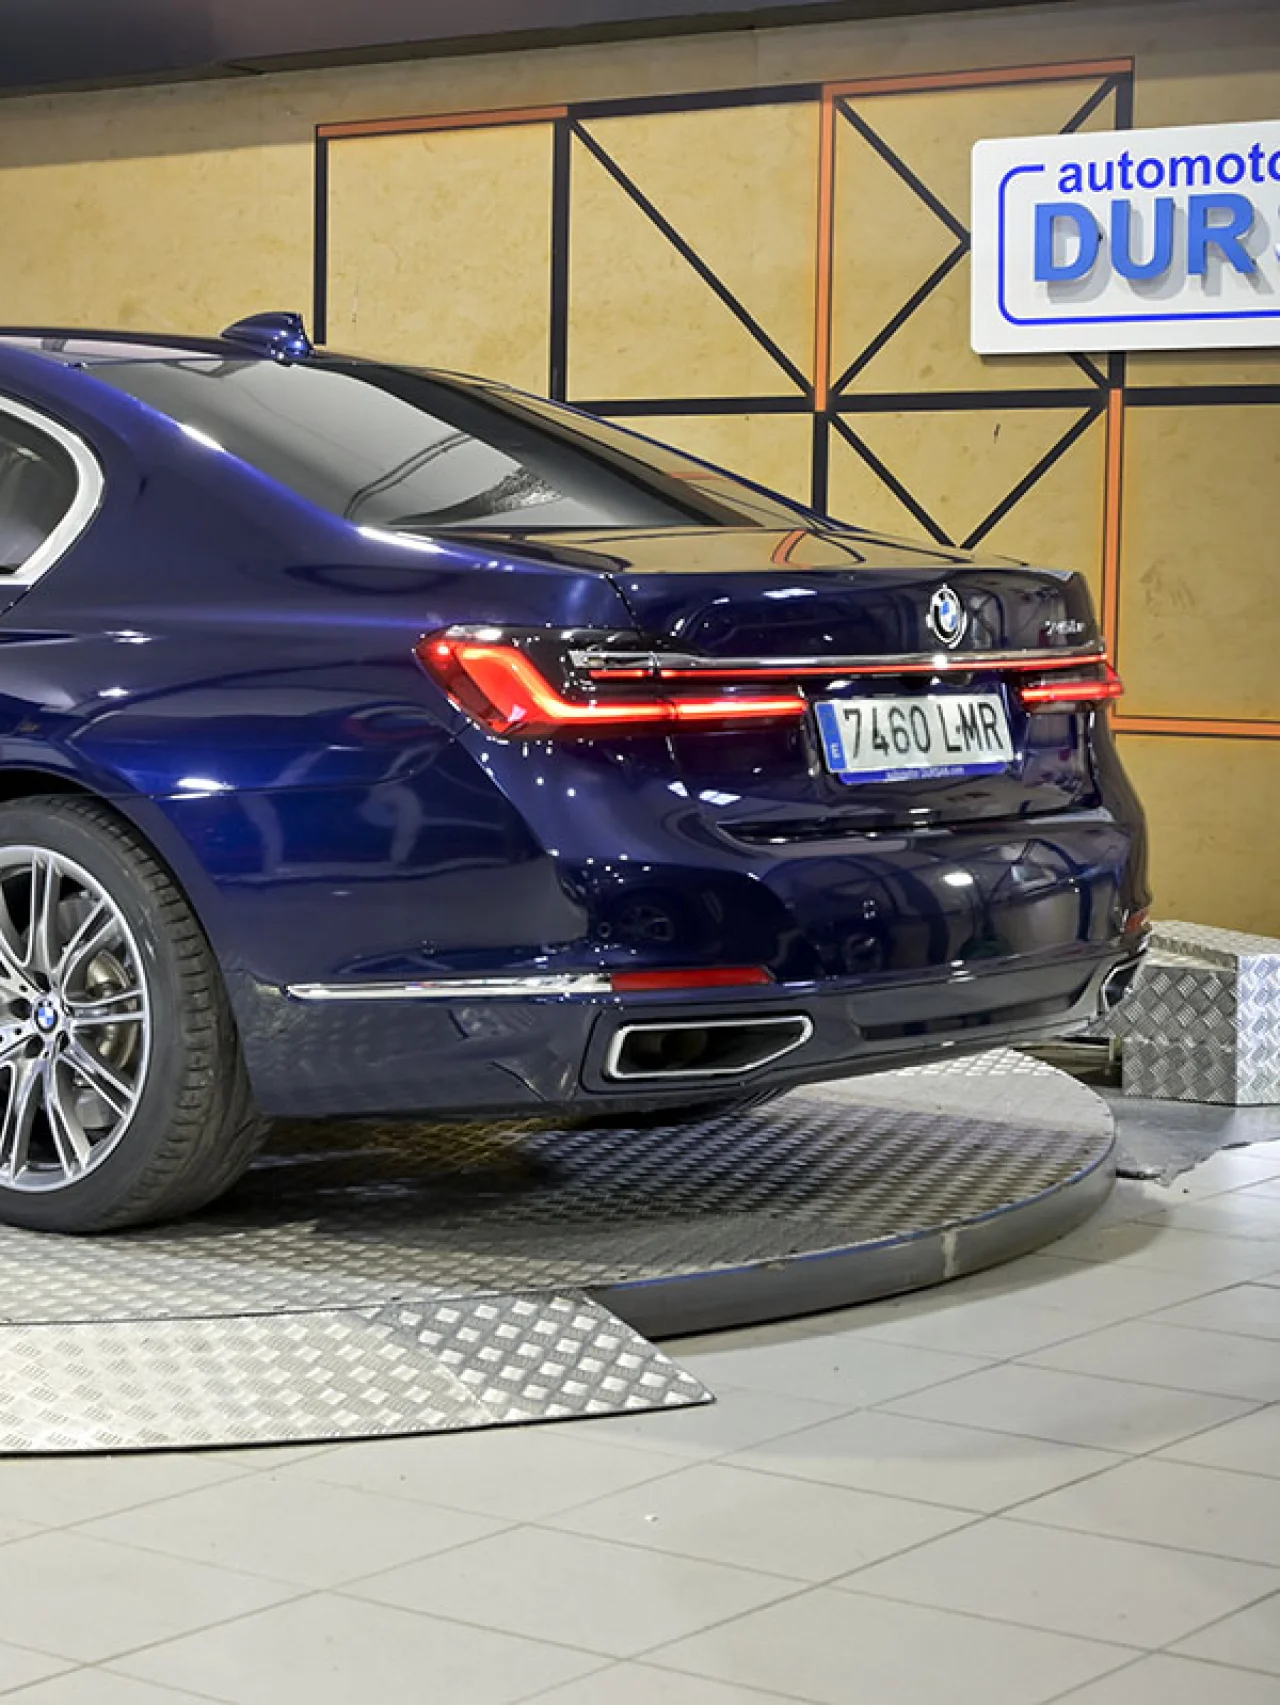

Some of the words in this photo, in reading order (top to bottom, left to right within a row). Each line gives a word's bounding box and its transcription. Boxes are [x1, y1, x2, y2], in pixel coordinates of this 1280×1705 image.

[1034, 193, 1280, 282] DUR
[843, 704, 931, 758] 7460
[937, 702, 1004, 752] LMR
